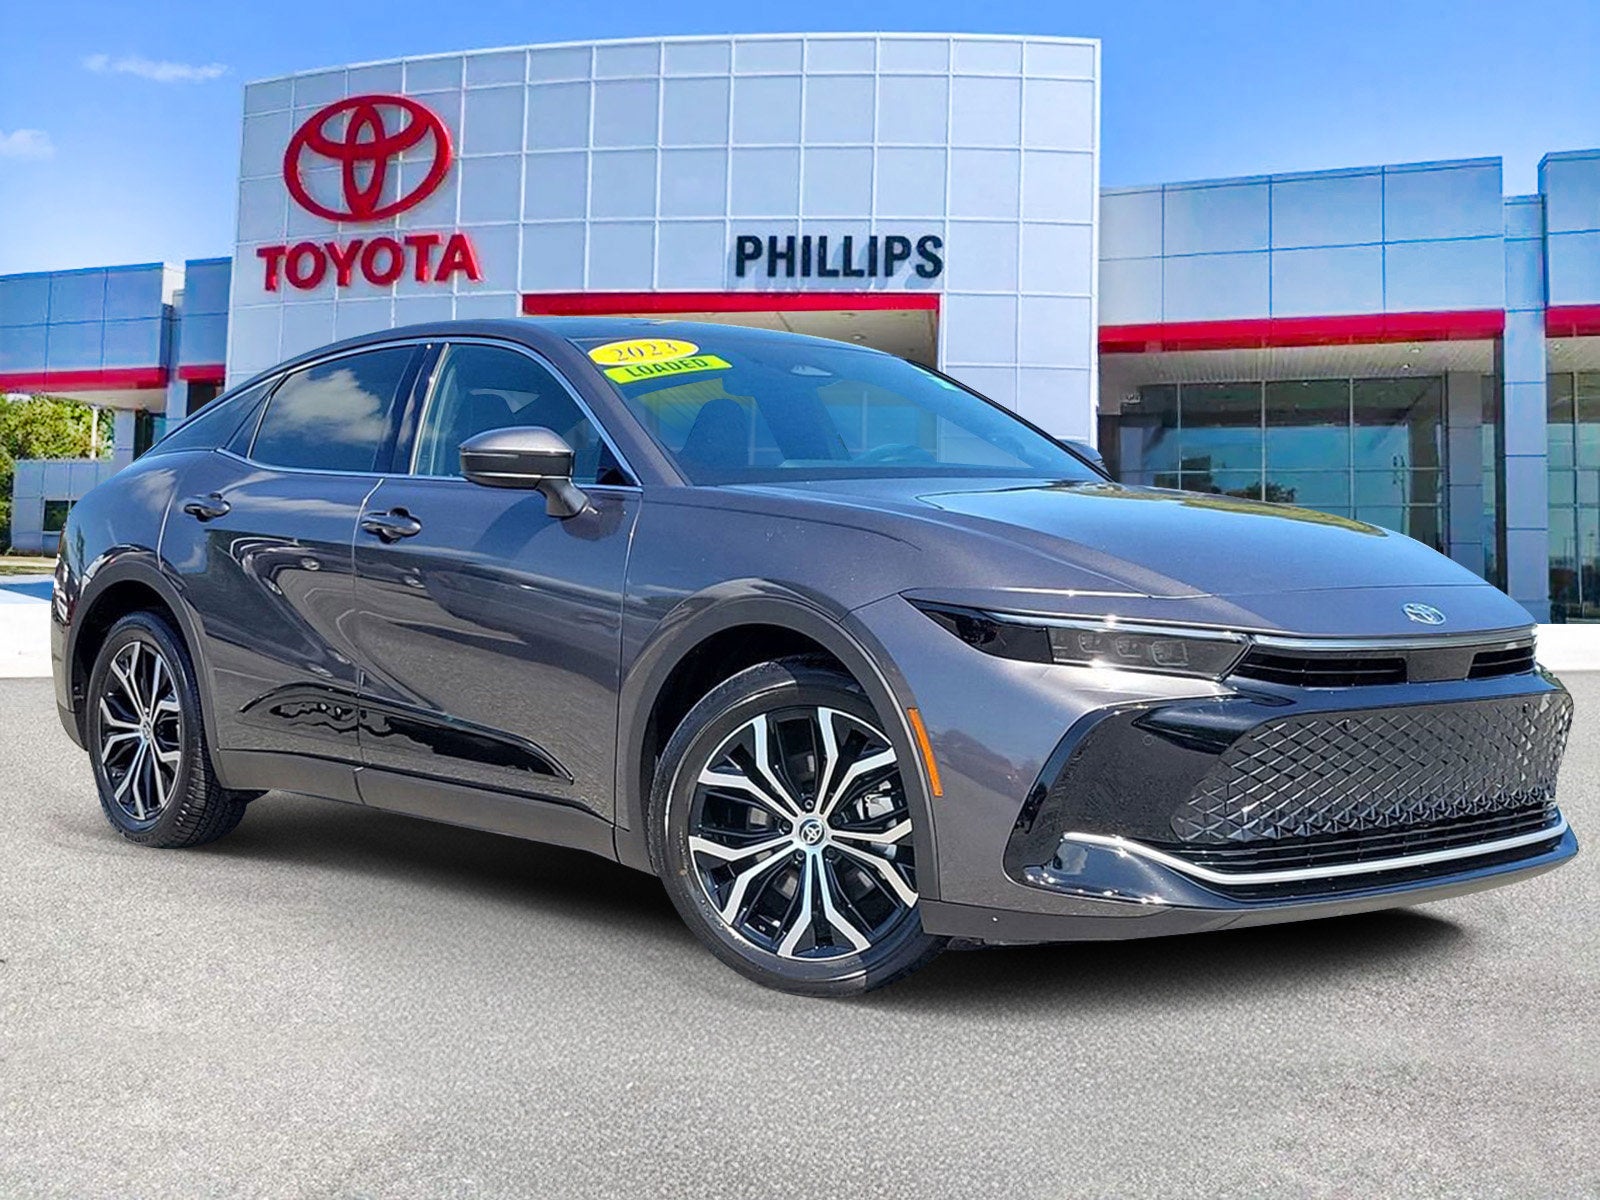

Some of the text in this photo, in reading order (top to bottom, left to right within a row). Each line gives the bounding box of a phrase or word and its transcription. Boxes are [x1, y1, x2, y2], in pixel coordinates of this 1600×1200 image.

[257, 233, 481, 292] TOYOTA
[735, 234, 944, 279] PHILLIPS
[612, 341, 679, 362] 2023
[626, 358, 709, 378] LOADED
